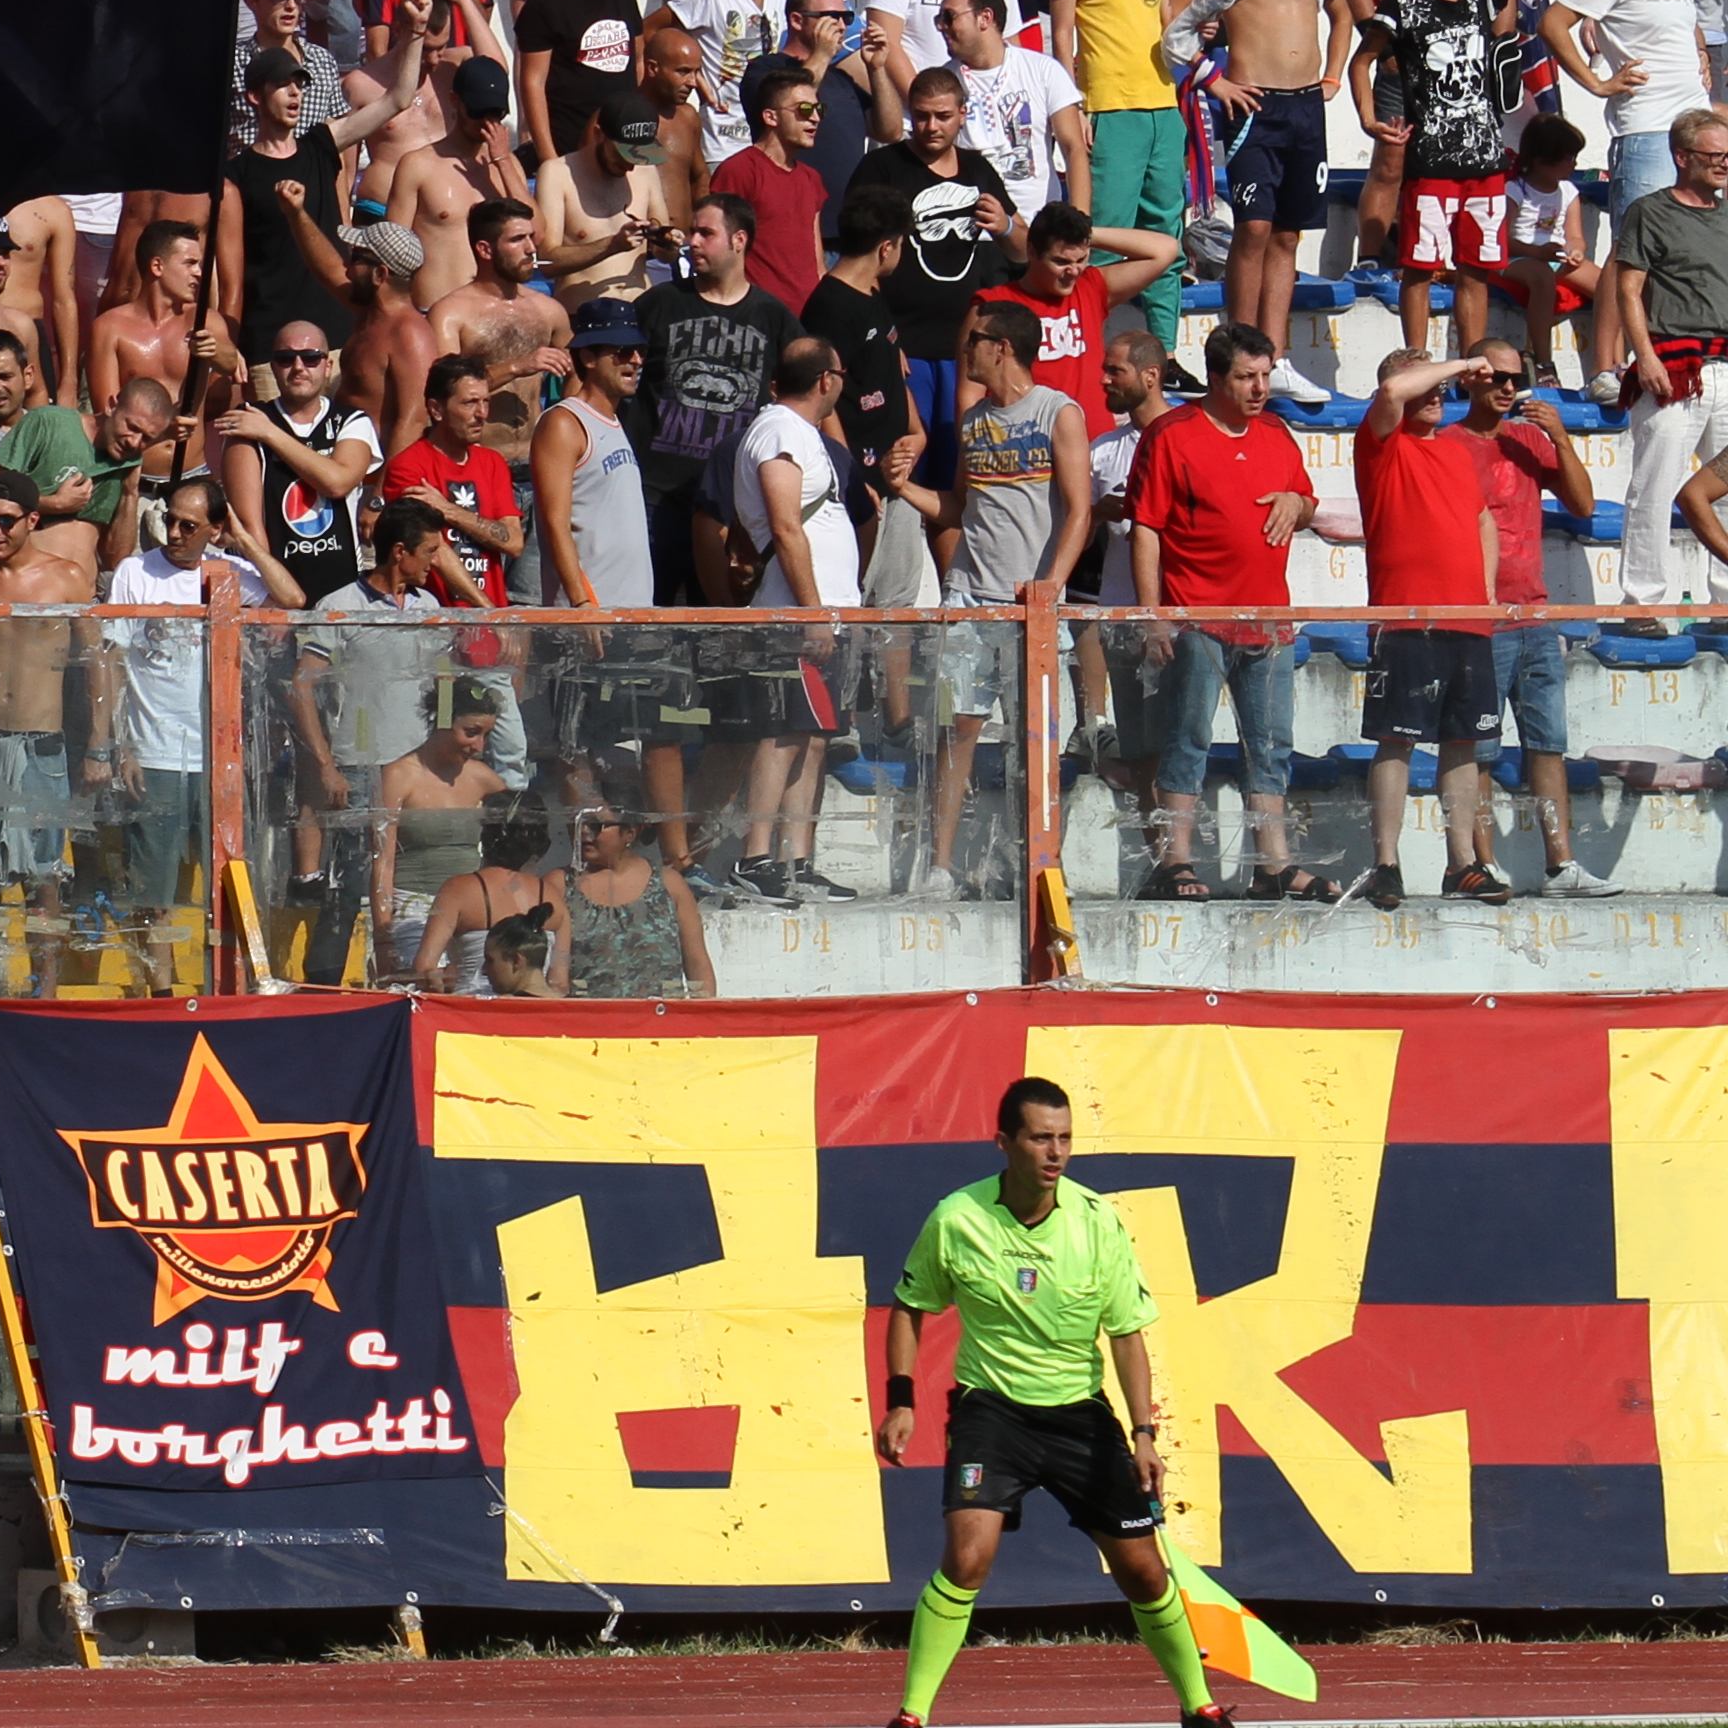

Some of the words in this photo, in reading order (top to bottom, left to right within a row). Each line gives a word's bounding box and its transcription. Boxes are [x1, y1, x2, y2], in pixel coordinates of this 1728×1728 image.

[717, 124, 751, 136] HAPP
[1316, 161, 1329, 194] 9
[1413, 194, 1508, 265] NY
[284, 533, 340, 560] pepsi
[1646, 671, 1680, 705] 13
[104, 1142, 340, 1222] CASERTA
[1002, 1248, 1053, 1262] DIADORA
[71, 1388, 468, 1486] borghetti
[1121, 1517, 1153, 1530] DIADO
